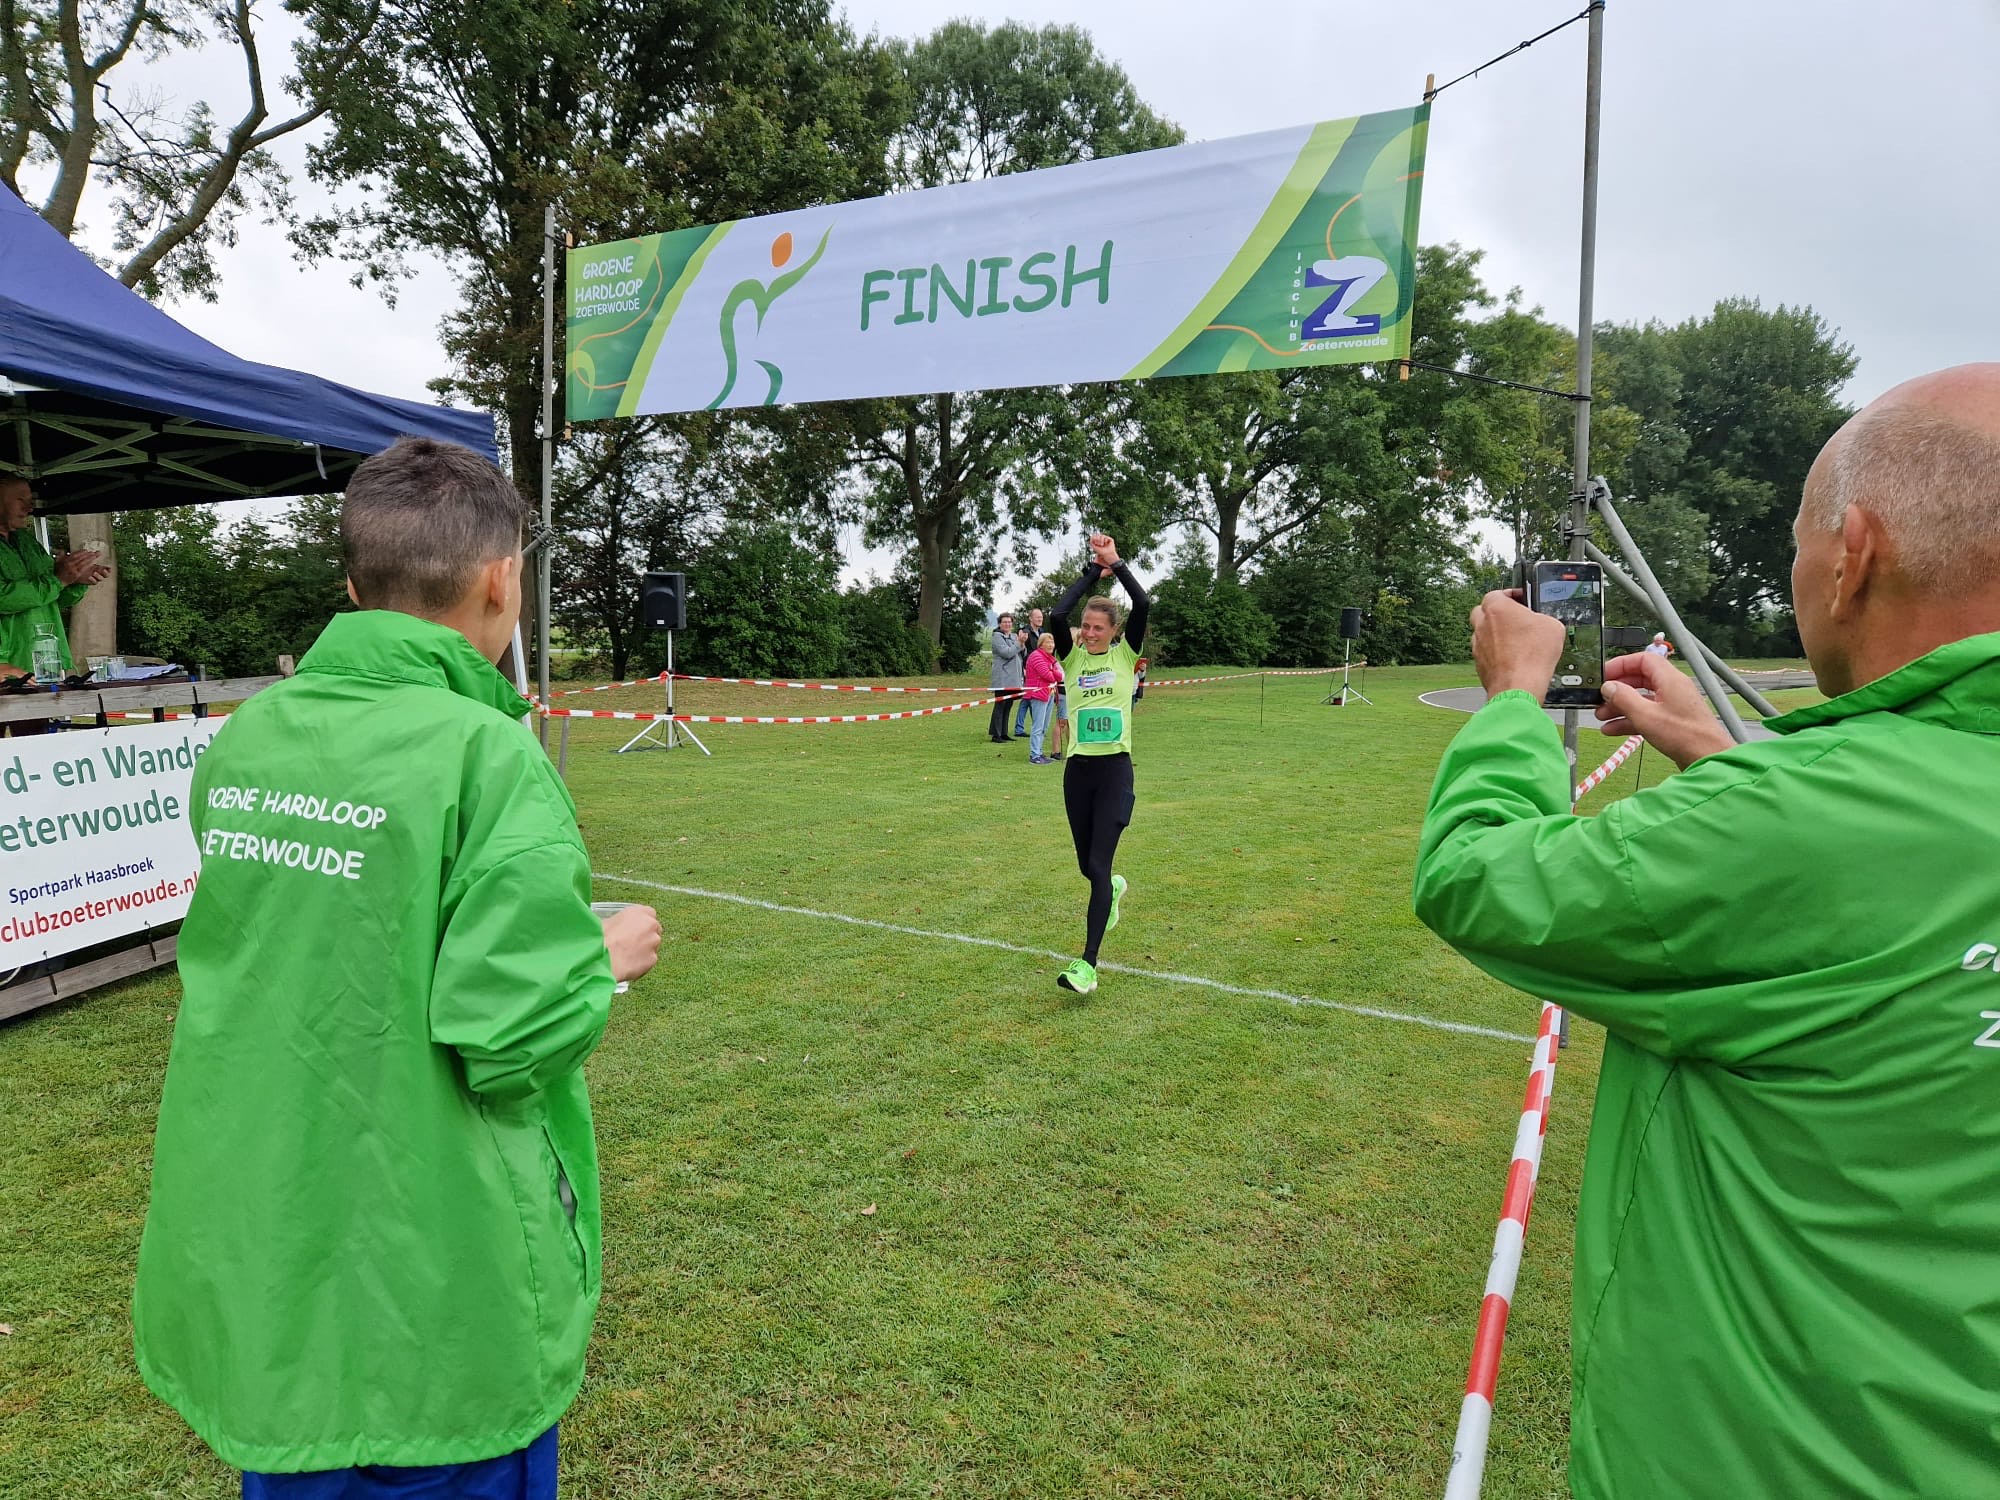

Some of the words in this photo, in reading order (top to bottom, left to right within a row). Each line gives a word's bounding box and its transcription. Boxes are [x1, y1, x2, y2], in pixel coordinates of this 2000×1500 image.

[582, 255, 634, 280] GROENE
[860, 239, 1114, 332] FINISH
[575, 278, 643, 303] HARDLOOP
[575, 298, 640, 319] ZOETERWOUDE
[1300, 336, 1388, 352] Zoeterwoude
[1083, 687, 1113, 698] 2018
[1086, 716, 1112, 733] 419
[0, 755, 42, 794] d-
[53, 756, 96, 787] en
[101, 733, 213, 779] Wande
[0, 789, 180, 852] eterwoude
[208, 786, 260, 811] OENE
[261, 790, 387, 830] HARDLOOP
[202, 828, 365, 880] ETERWOUDE
[9, 873, 83, 906] Sportpark
[85, 857, 154, 886] Haasbroek
[1, 870, 198, 943] clubzoeterwoude.nl
